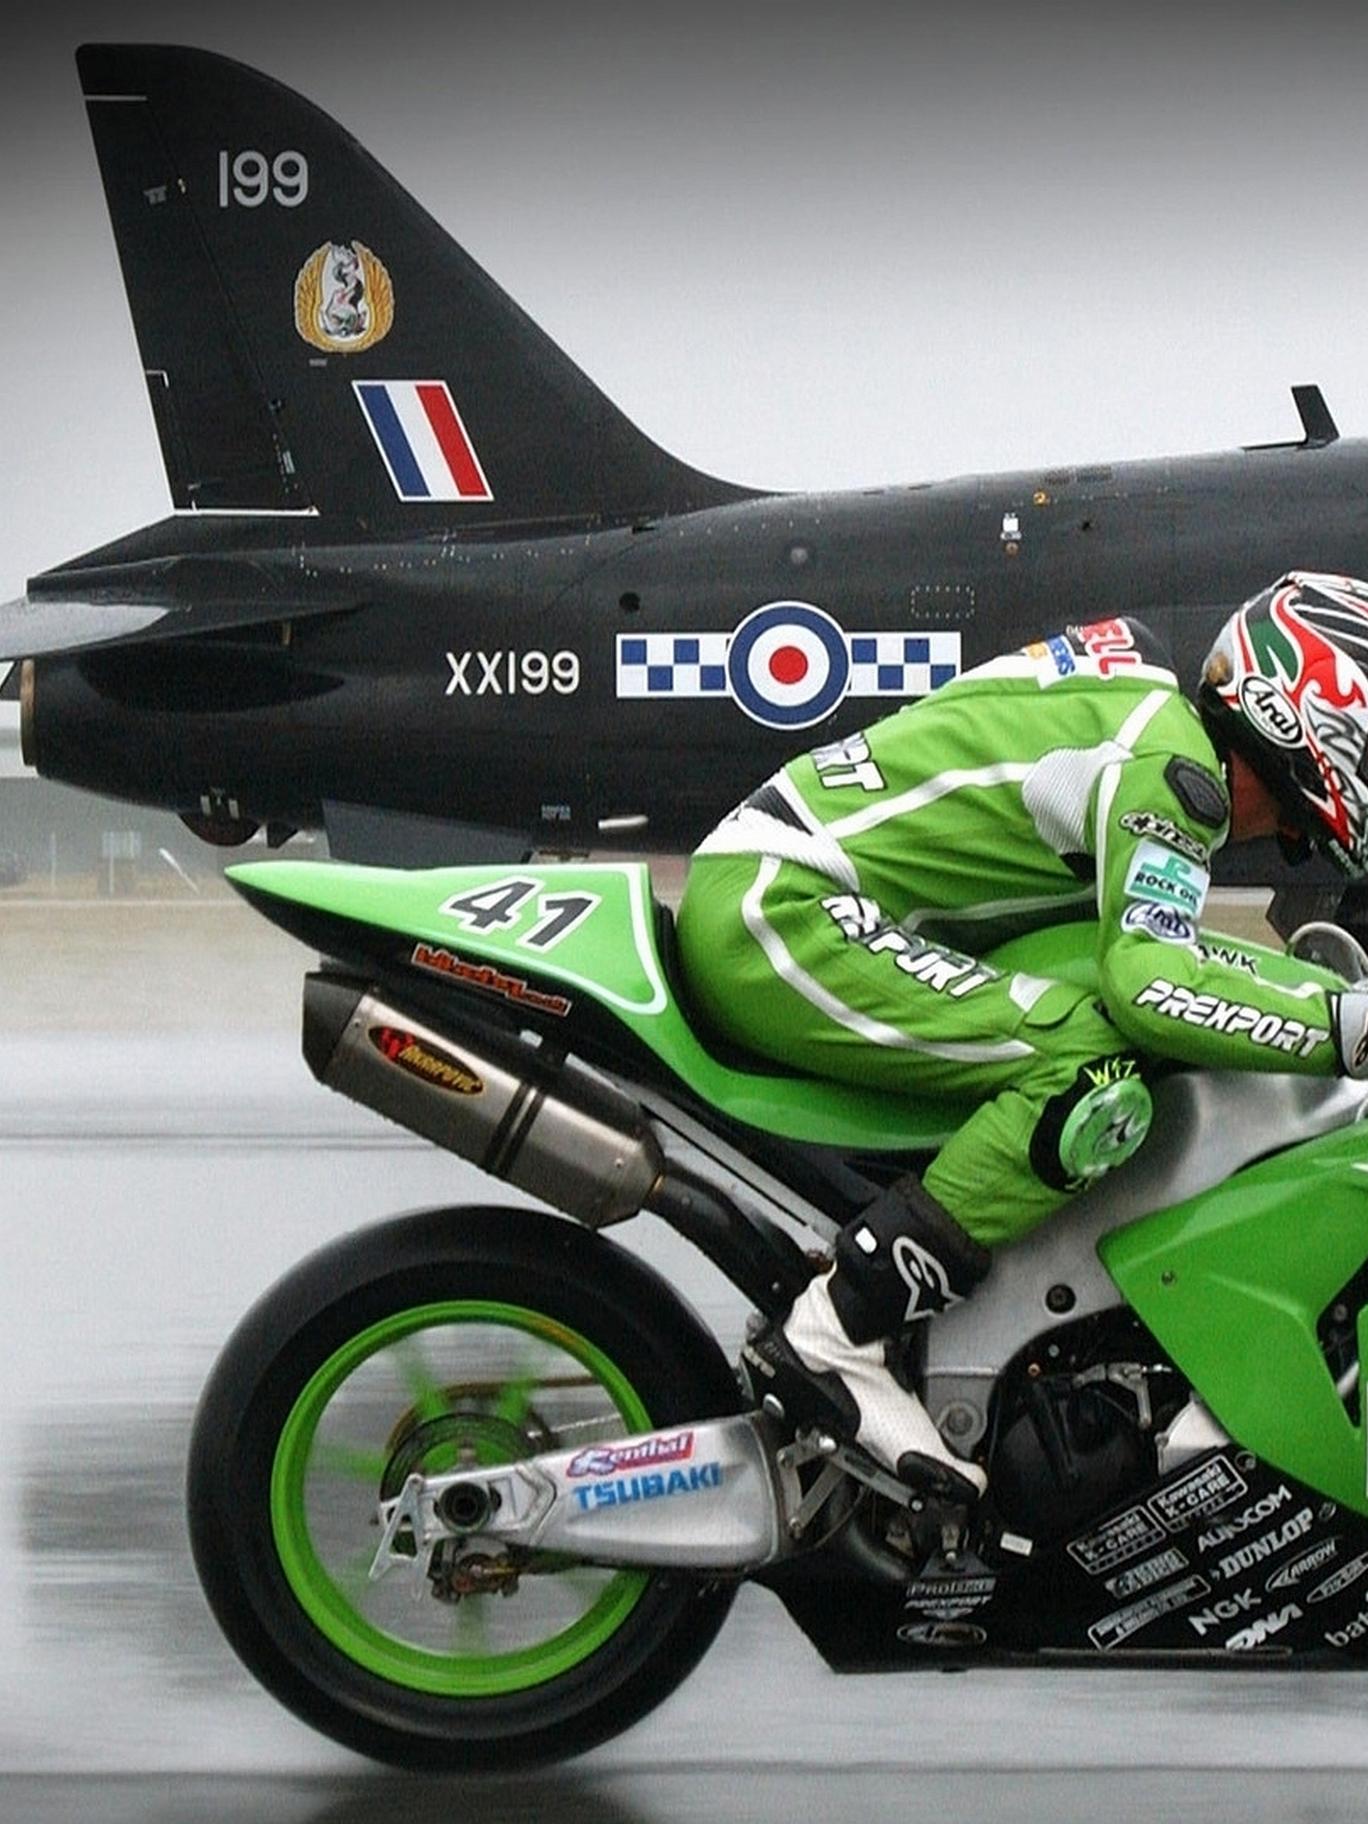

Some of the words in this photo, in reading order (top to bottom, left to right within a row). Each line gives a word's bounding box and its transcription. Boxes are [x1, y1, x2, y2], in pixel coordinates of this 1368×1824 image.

[219, 150, 309, 208] 199
[445, 650, 580, 695] XX199
[1245, 689, 1299, 735] Arai
[1134, 871, 1177, 895] ROCK
[443, 877, 598, 951] 41
[1135, 978, 1330, 1058] PREXPORT
[573, 1462, 721, 1510] TSUBAKI
[1217, 1507, 1314, 1579] DUNLOP
[1188, 1588, 1262, 1636] NGK
